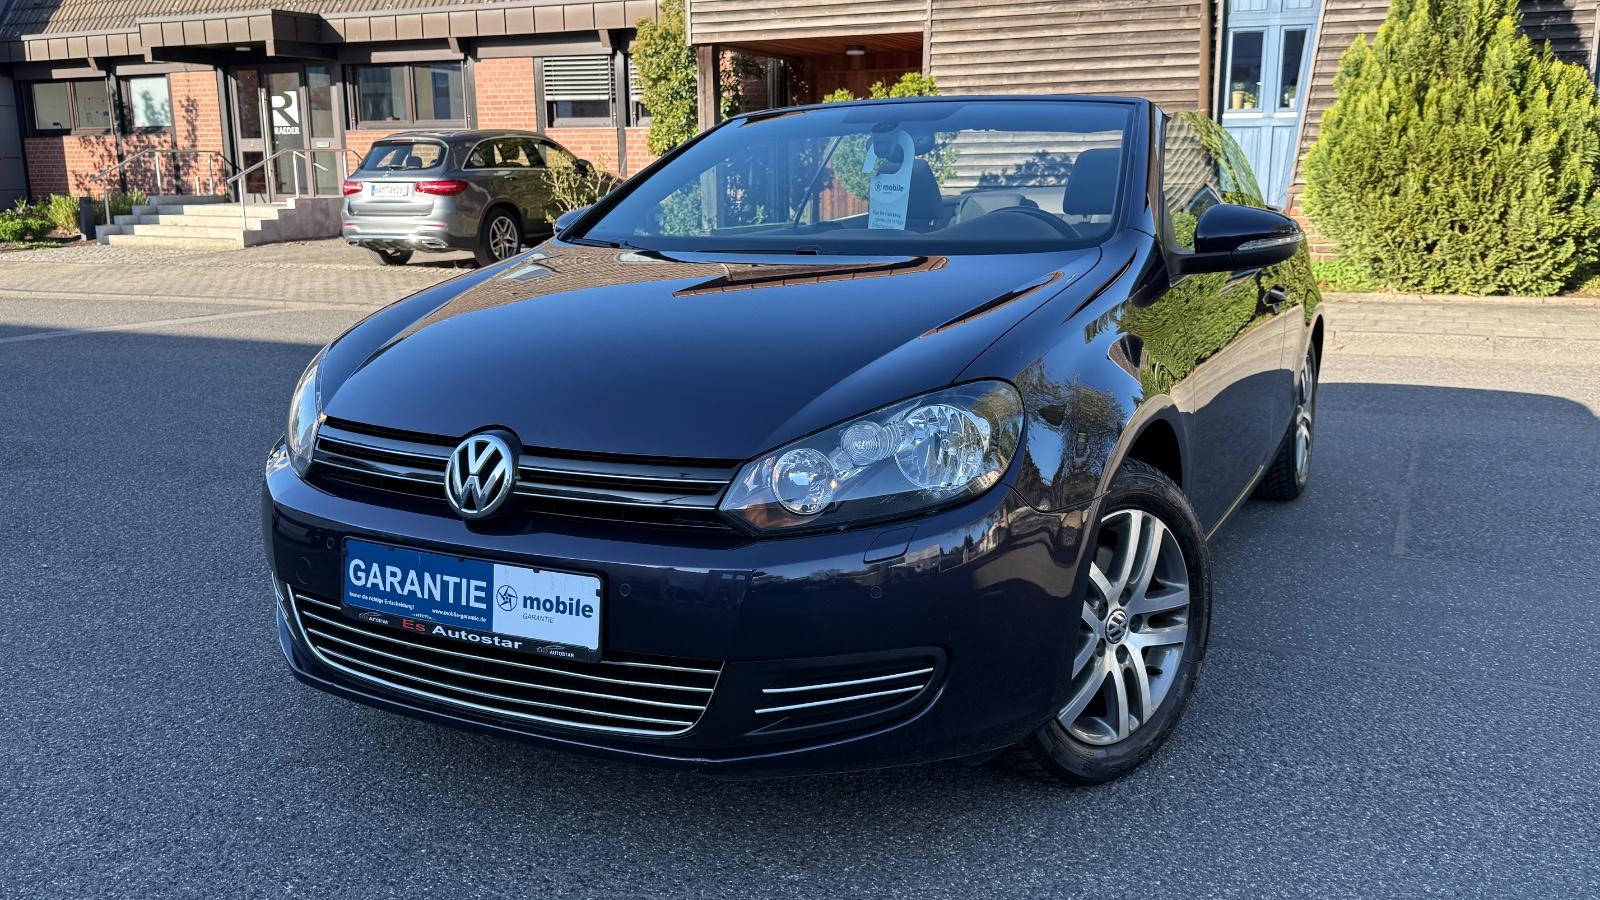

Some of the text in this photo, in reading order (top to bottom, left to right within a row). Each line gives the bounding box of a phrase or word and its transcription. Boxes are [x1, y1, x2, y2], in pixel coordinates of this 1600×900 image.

[273, 126, 300, 135] RAEDER
[882, 183, 904, 192] mobile
[446, 435, 512, 514] VW
[349, 558, 487, 609] GARANTIE
[522, 595, 594, 618] mobile
[431, 608, 487, 622] www.mobile-garantie.de
[522, 613, 555, 624] GARANTIE
[402, 618, 523, 649] Es Autostar
[549, 649, 575, 658] AUTOSTAR
